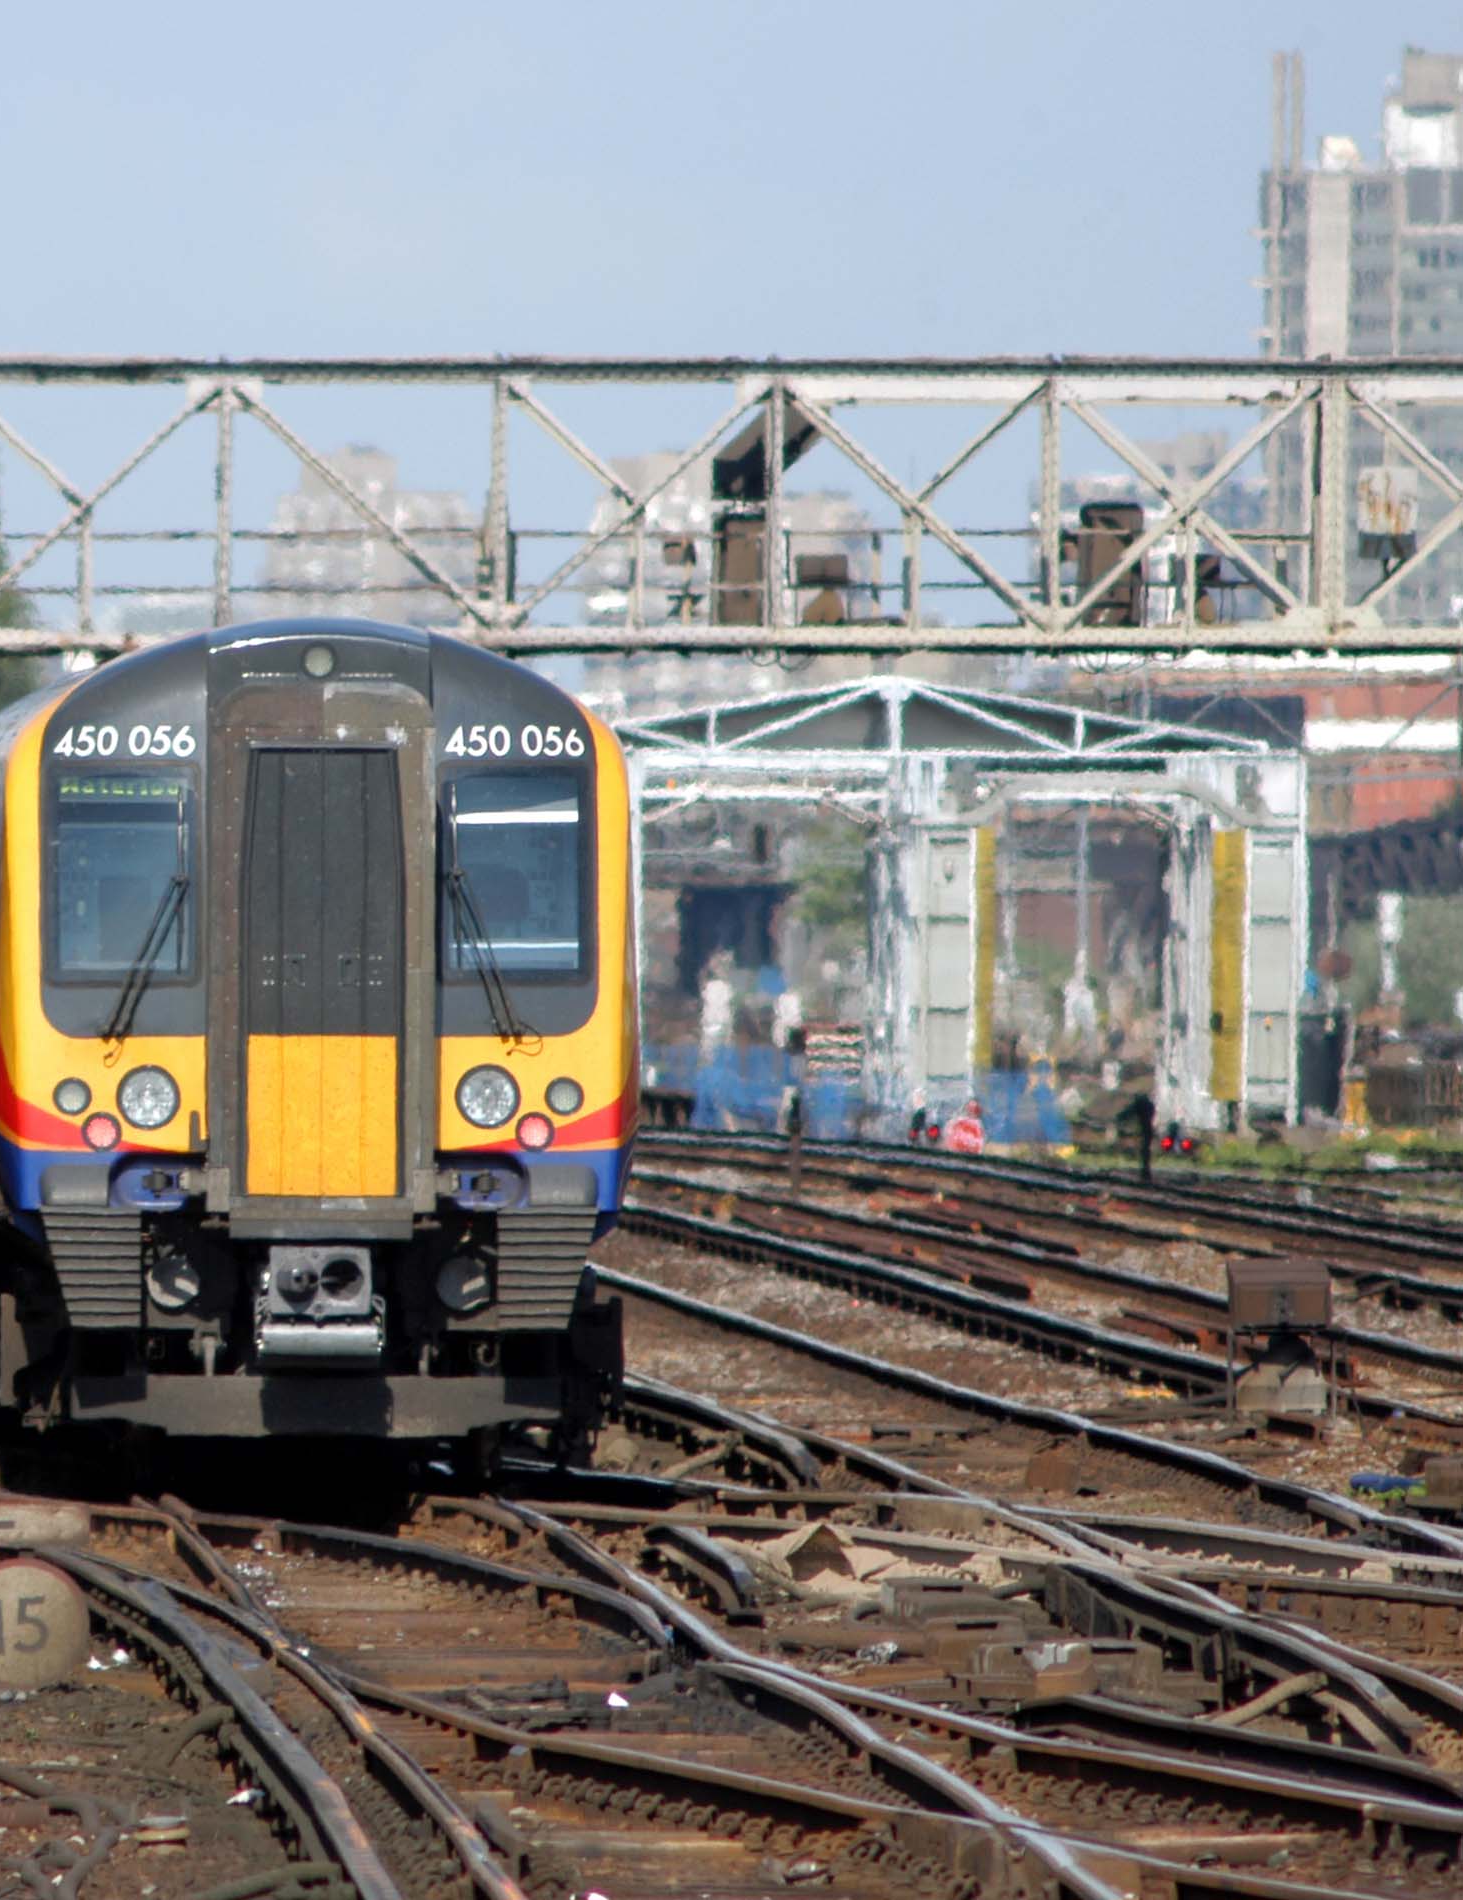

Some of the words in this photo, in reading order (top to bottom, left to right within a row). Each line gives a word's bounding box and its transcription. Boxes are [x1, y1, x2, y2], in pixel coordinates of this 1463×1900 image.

[53, 725, 119, 757] 450
[128, 724, 196, 757] 056
[444, 725, 511, 757] 450
[521, 724, 585, 757] 056
